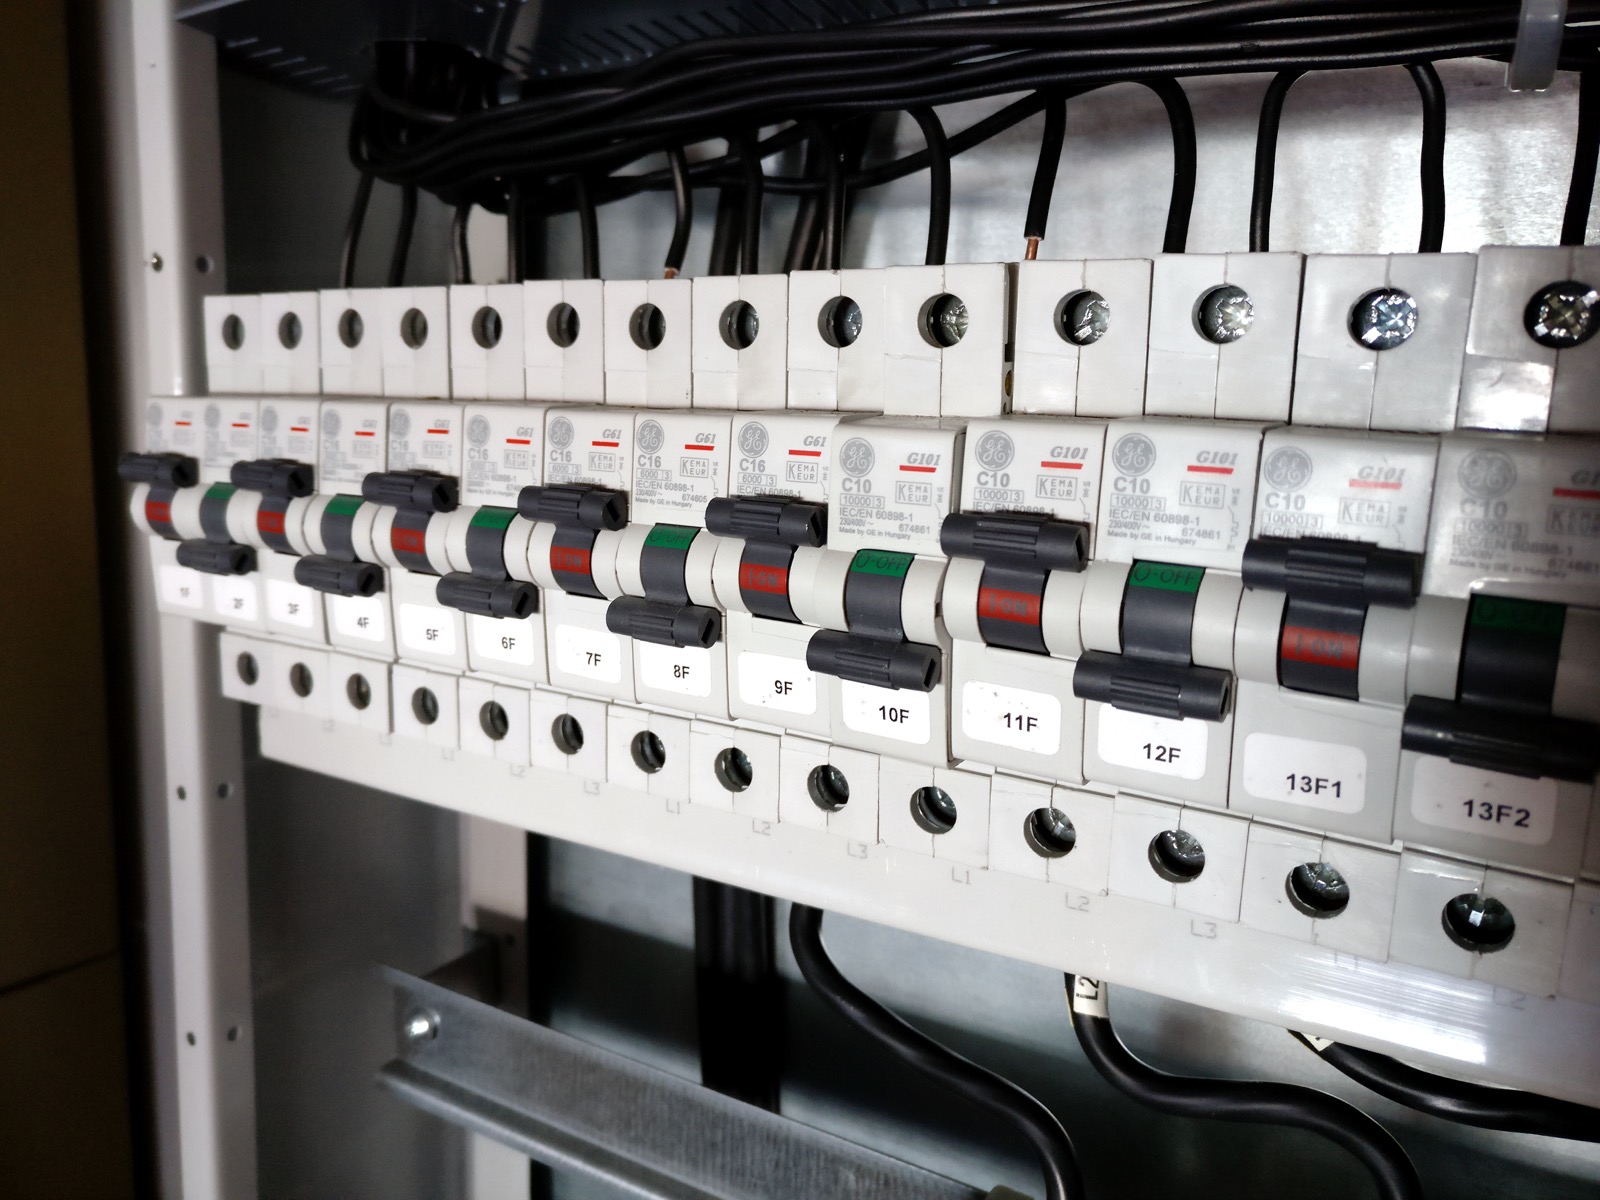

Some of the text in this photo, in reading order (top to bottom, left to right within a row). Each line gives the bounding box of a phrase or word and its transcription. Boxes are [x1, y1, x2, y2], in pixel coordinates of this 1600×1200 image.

[517, 427, 534, 438] G61
[602, 428, 622, 440] G61
[695, 432, 717, 444] G61
[803, 435, 827, 447] G61
[468, 448, 489, 461] C16
[550, 451, 572, 463] C16
[907, 452, 941, 466] G101
[1050, 446, 1088, 460] G101
[1196, 450, 1238, 466] G101
[638, 454, 662, 468] C16
[739, 458, 766, 473] C16
[552, 465, 580, 475] 6000 3
[641, 470, 670, 480] 6000 3
[1358, 465, 1406, 482] G101
[742, 475, 774, 486] 6000 3
[842, 478, 872, 494] C10
[977, 471, 1010, 488] C10
[1113, 476, 1150, 494] C10
[636, 482, 694, 493] IEC/EN 60898-1
[737, 485, 766, 495] IEC/EN
[844, 495, 882, 508] 10000 3
[978, 489, 1020, 502] 10000 3
[1115, 496, 1162, 510] 10000 3
[1265, 492, 1306, 511] C10
[840, 507, 913, 521] IEC/EN 60898-1
[1460, 498, 1508, 518] C10
[1109, 509, 1200, 526] IEC/EN 60898-1
[1267, 511, 1319, 528] 10000 3
[839, 526, 856, 534] Made
[866, 528, 876, 536] GE
[884, 530, 911, 541] Hungary
[1107, 529, 1128, 538] Made
[1129, 531, 1138, 541] by
[1140, 532, 1153, 541] GE
[1164, 534, 1196, 546] Hungary
[357, 617, 369, 629] 4F
[426, 629, 439, 641] 5F
[502, 637, 516, 650] 6F
[586, 652, 602, 666] 7F
[673, 665, 690, 679] 8F
[774, 680, 793, 696] 9F
[879, 705, 909, 724] 10F
[1003, 712, 1038, 732] 11F
[1143, 743, 1181, 764] 12F
[509, 762, 525, 778] L2
[584, 780, 600, 796] L3
[1286, 773, 1342, 798] 13F1
[666, 799, 681, 815] L1
[1463, 799, 1530, 828] 13F2
[752, 819, 771, 837] L2
[847, 841, 868, 860] L3
[951, 865, 971, 885] L1
[1065, 891, 1090, 913] L2
[1190, 919, 1218, 940] L3
[1076, 975, 1099, 1001] L2
